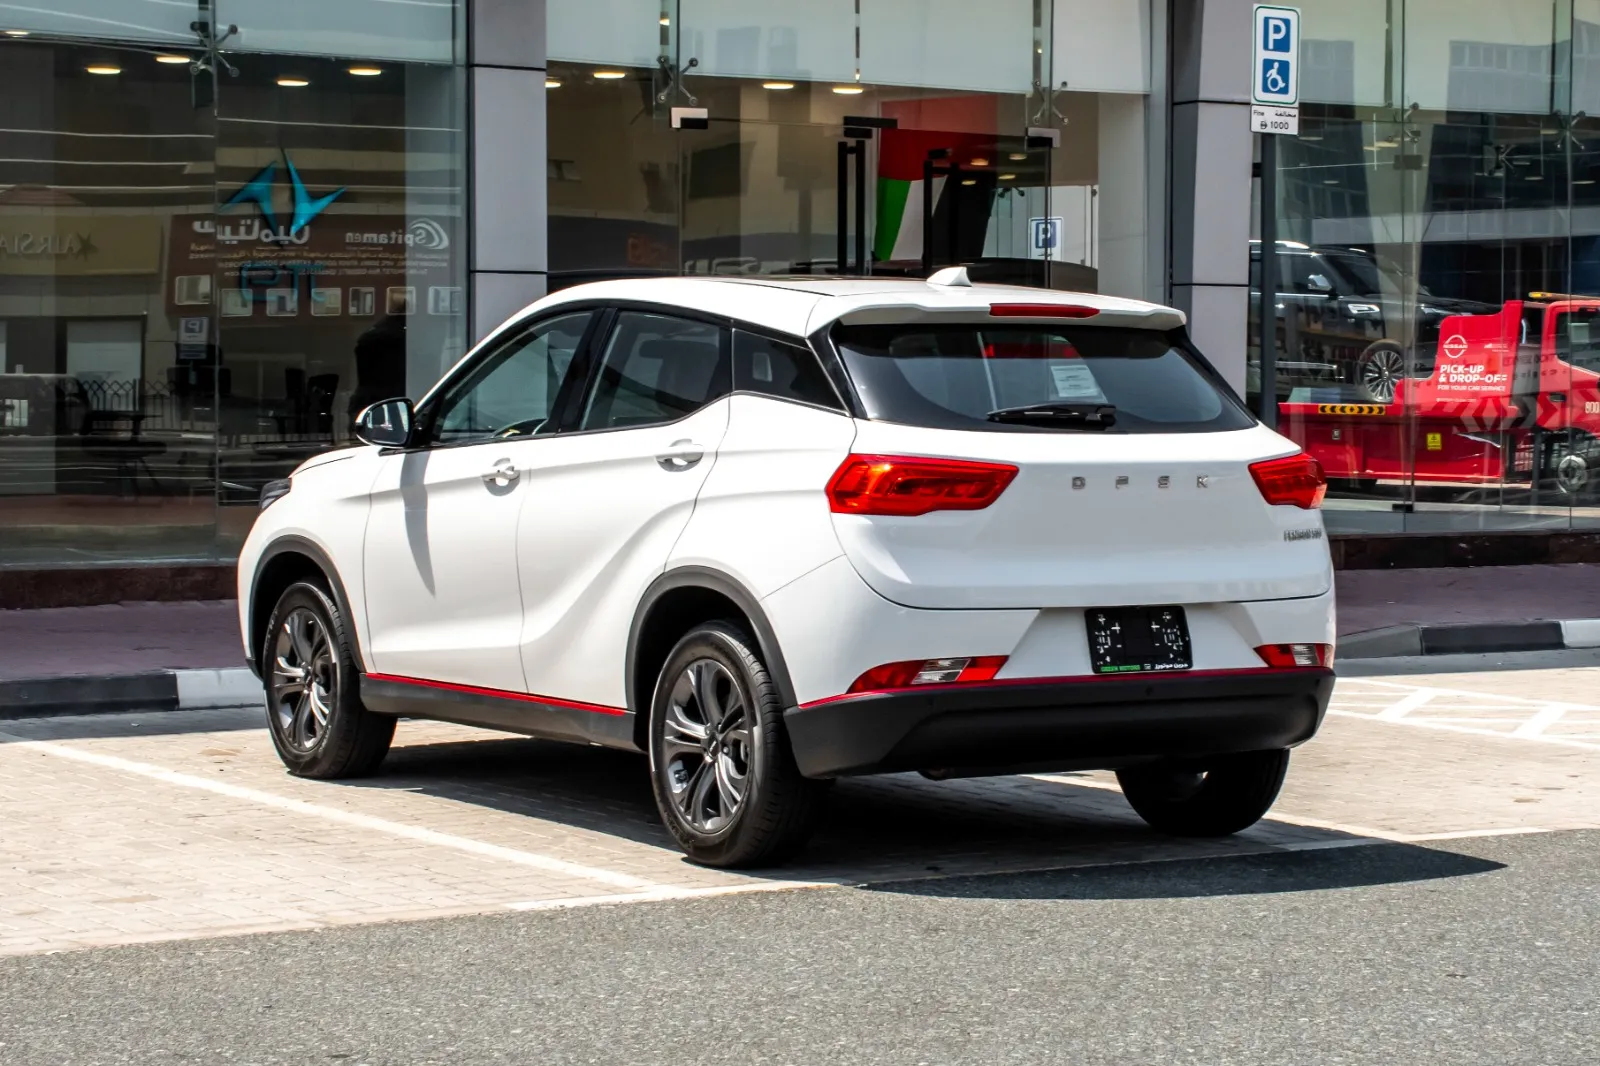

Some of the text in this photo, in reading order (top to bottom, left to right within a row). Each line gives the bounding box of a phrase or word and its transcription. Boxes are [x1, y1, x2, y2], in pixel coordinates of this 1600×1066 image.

[1267, 18, 1287, 50] P
[1253, 109, 1265, 117] Fine
[1270, 120, 1289, 130] 1000
[1440, 364, 1485, 374] PICK-UP
[1438, 374, 1448, 383] &
